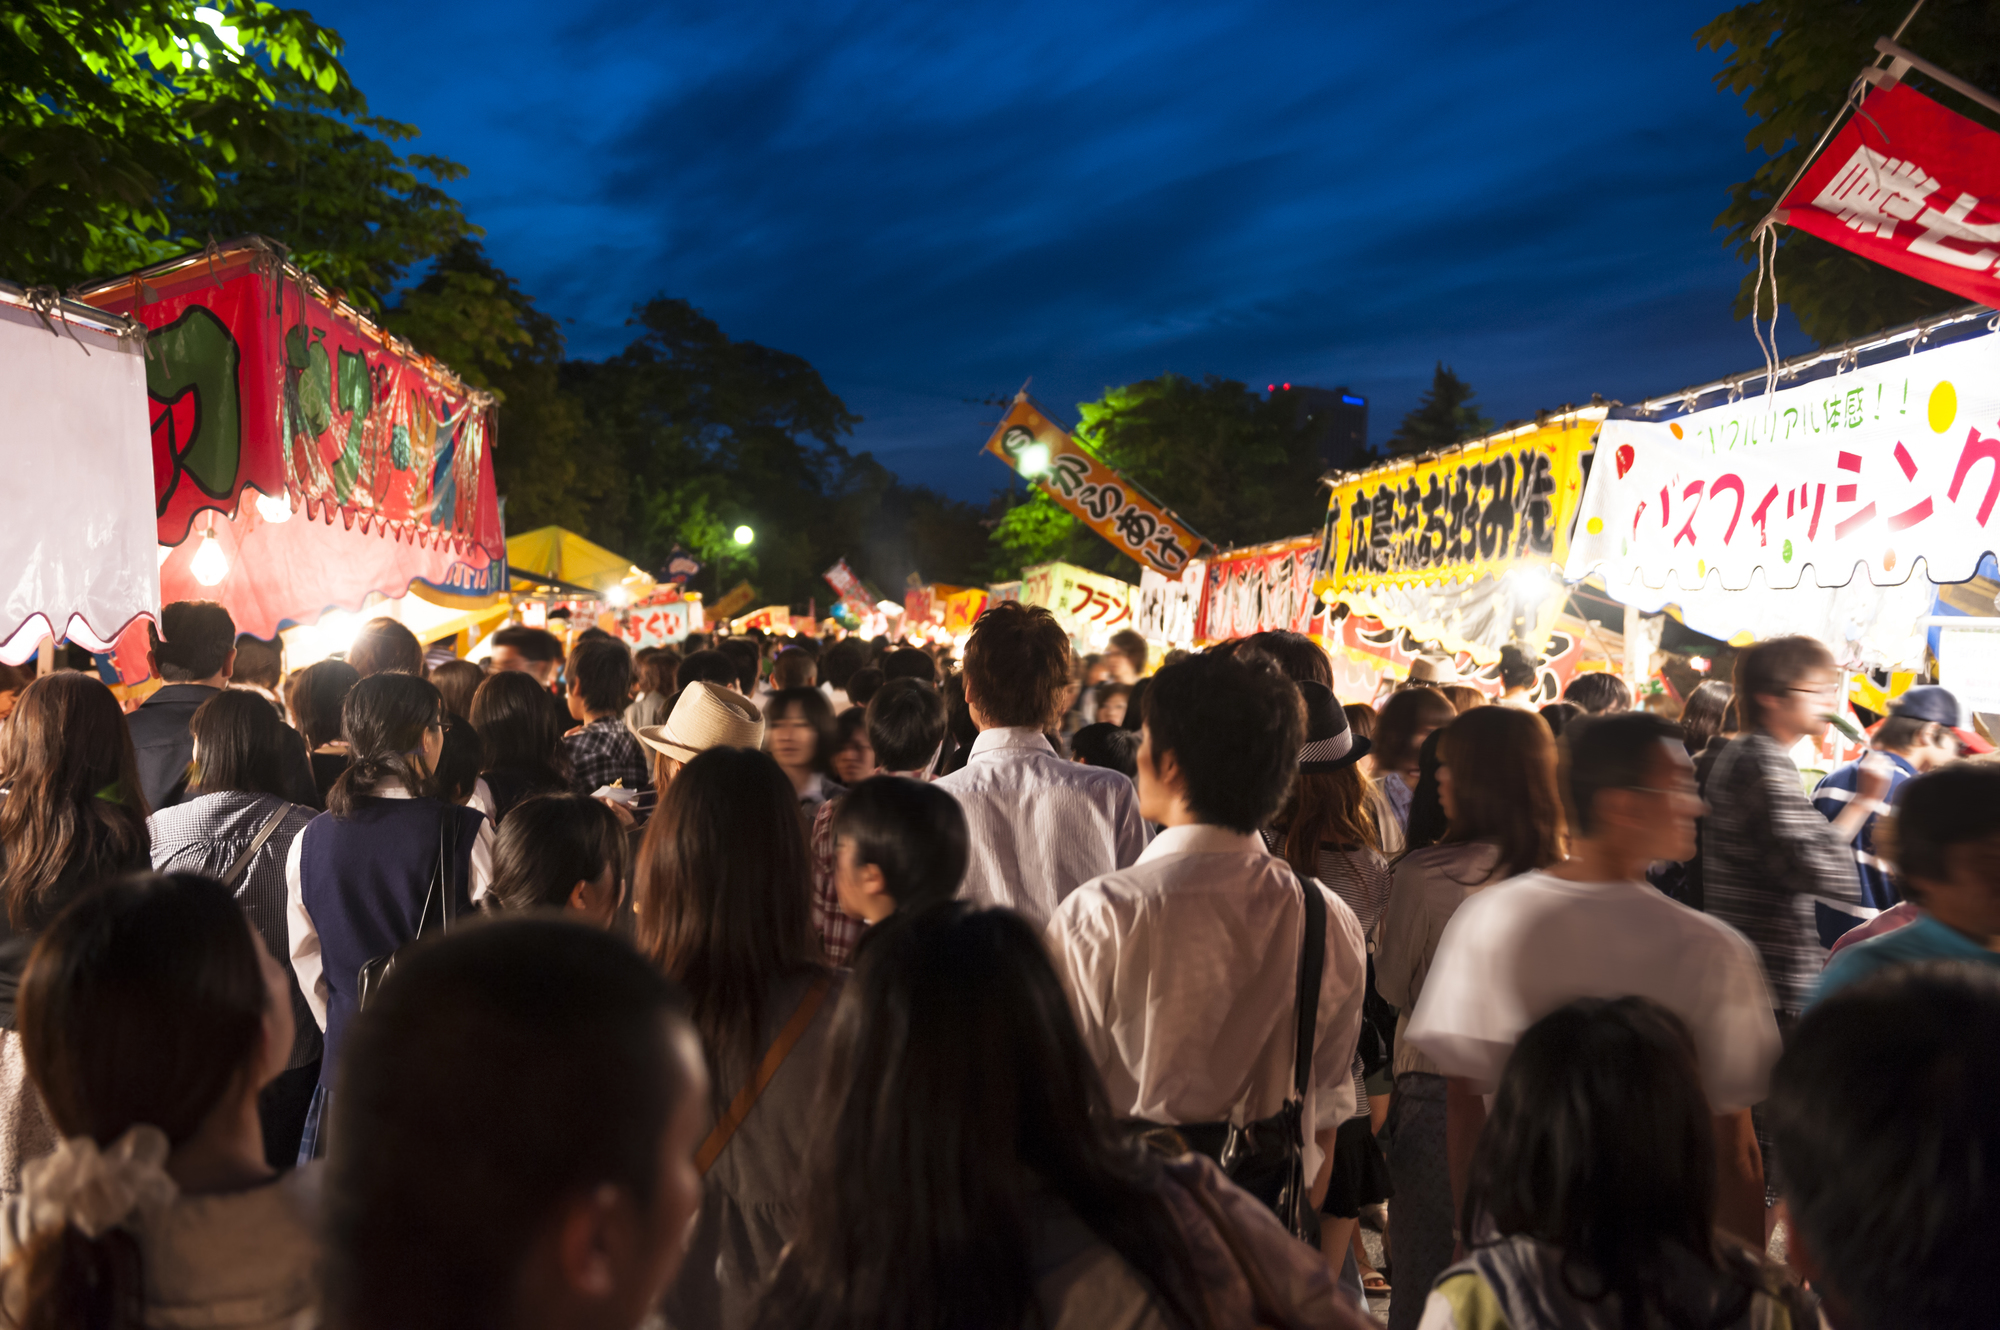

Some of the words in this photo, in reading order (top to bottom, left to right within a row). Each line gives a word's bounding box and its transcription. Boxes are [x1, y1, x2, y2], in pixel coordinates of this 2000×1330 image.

[1047, 454, 1189, 574] からあげ
[1071, 583, 1133, 625] フラン
